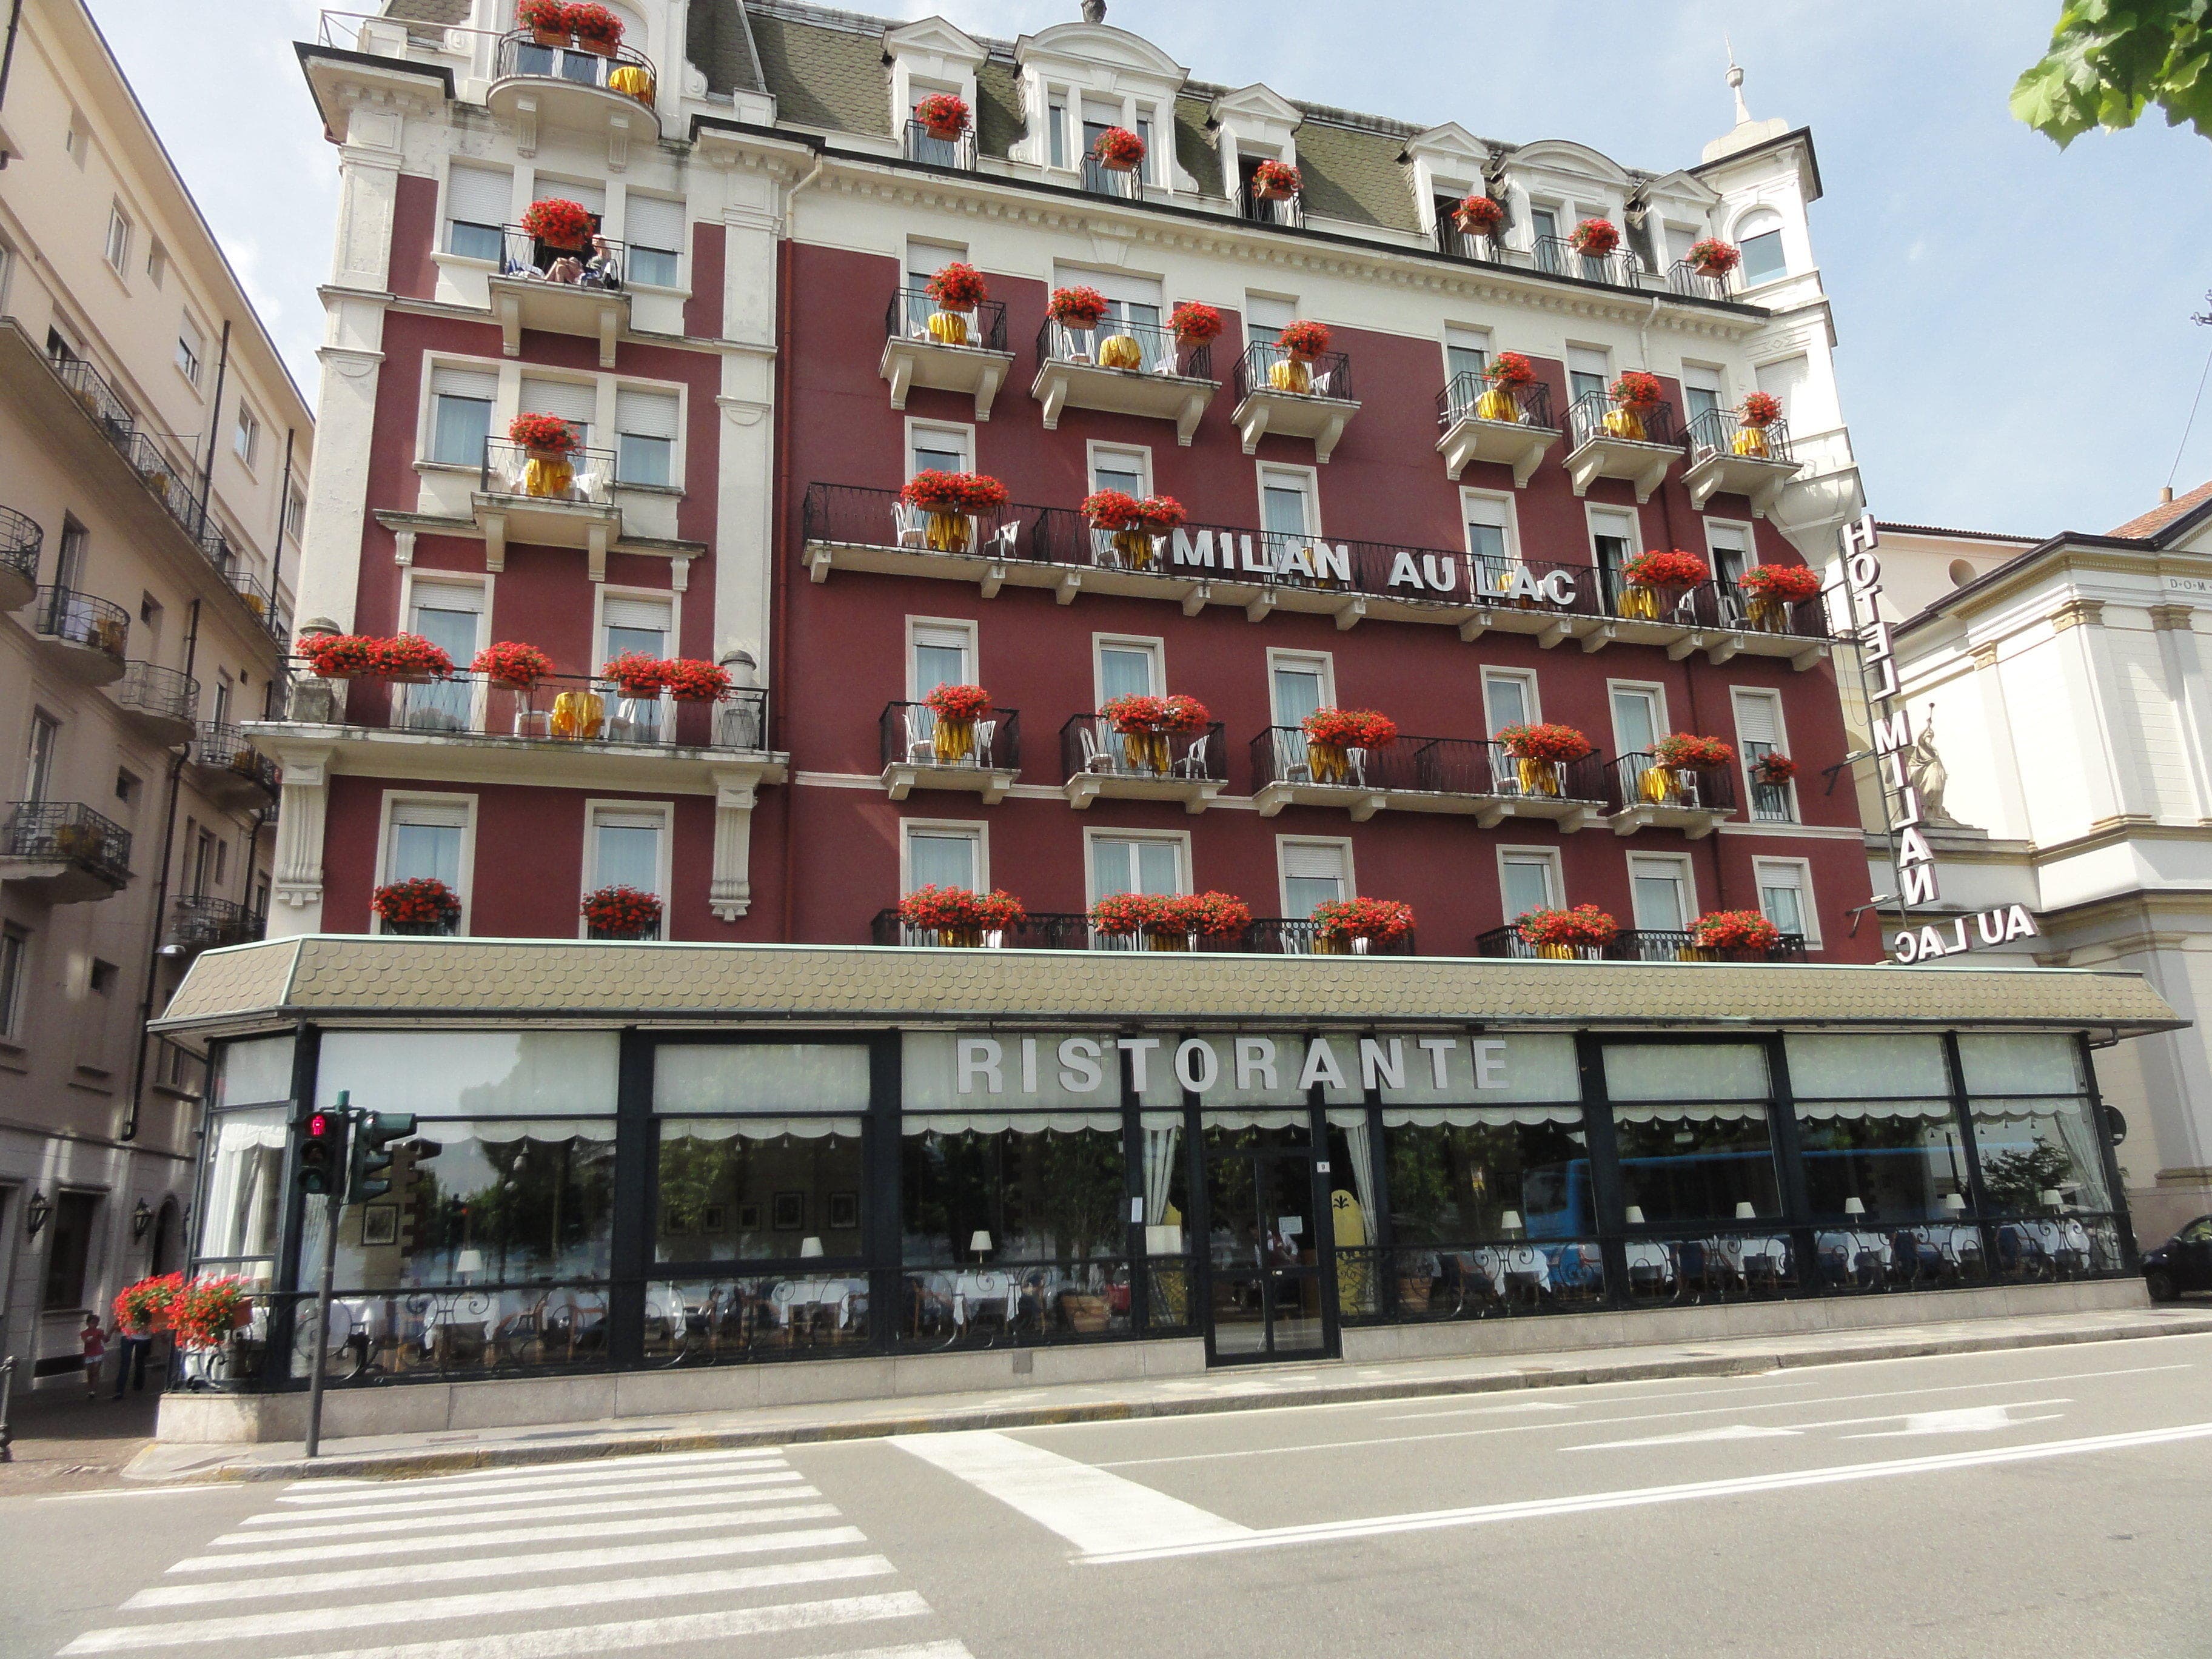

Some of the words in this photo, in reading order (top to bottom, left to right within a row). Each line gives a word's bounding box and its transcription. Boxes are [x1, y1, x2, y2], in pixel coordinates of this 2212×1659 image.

[1172, 528, 1351, 581] MILAN
[1389, 552, 1455, 592] AU
[1473, 560, 1576, 605] LAC
[956, 1037, 1511, 1094] RISTORANTE
